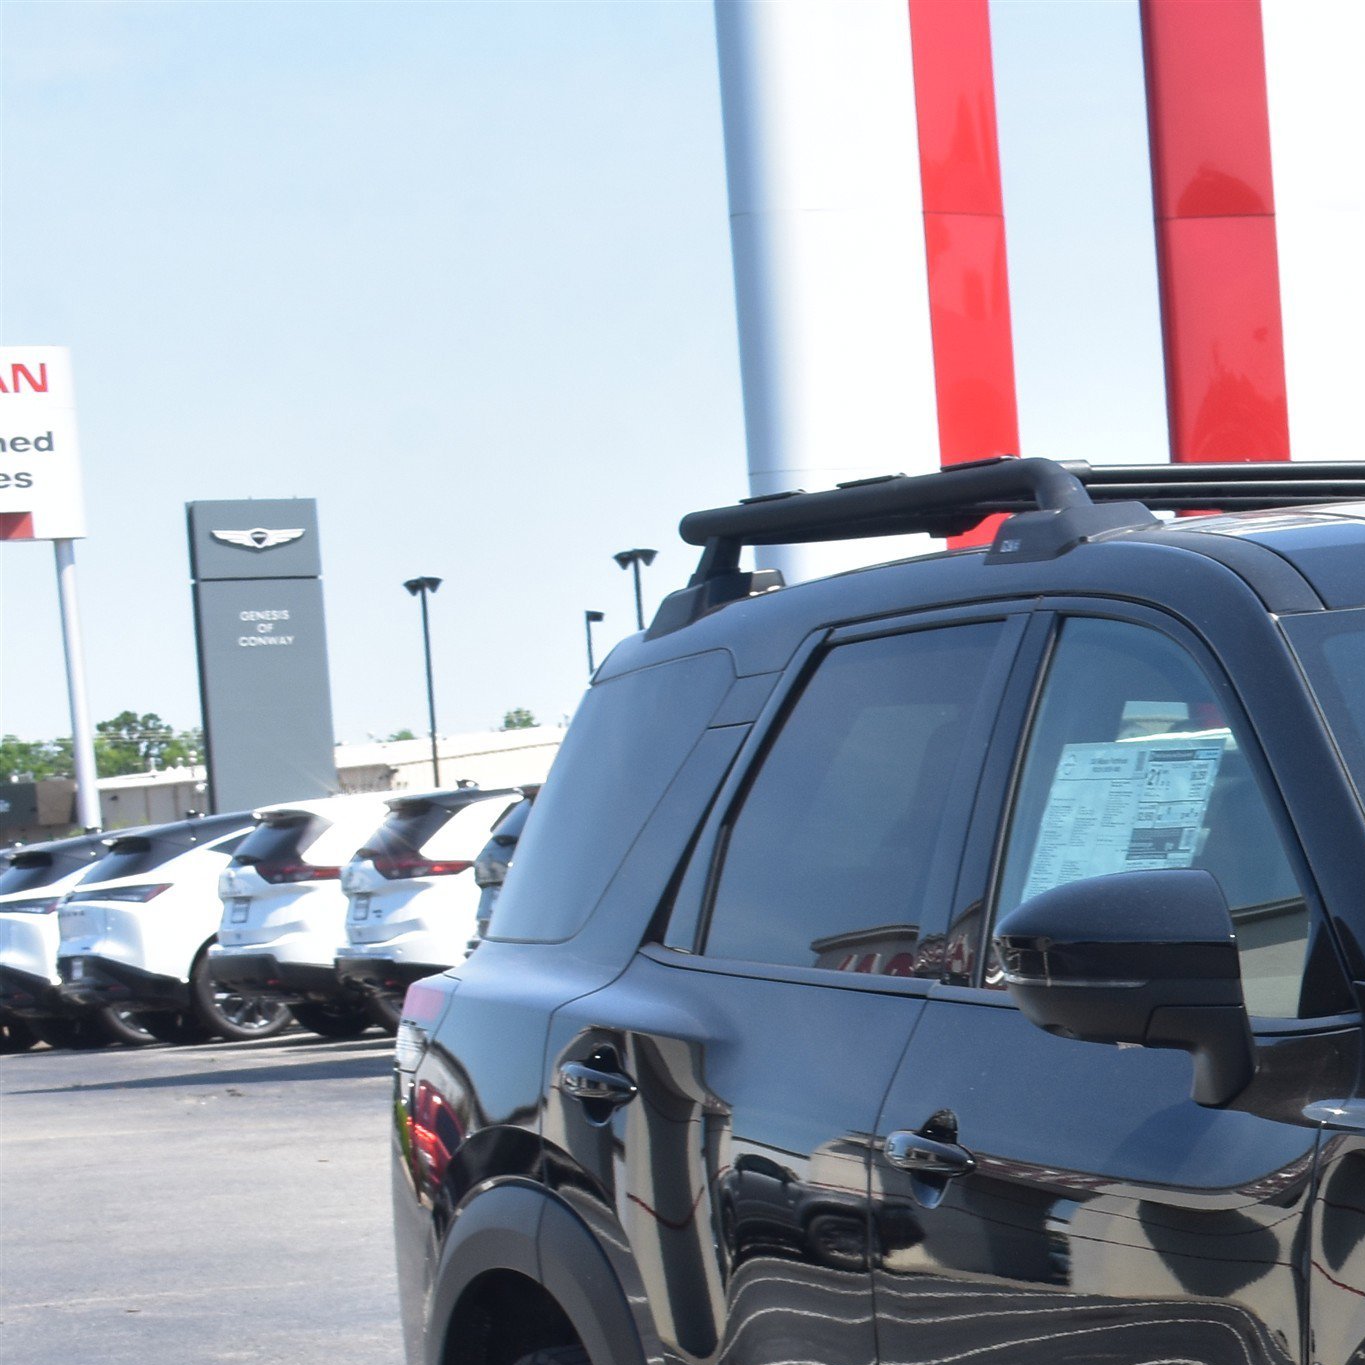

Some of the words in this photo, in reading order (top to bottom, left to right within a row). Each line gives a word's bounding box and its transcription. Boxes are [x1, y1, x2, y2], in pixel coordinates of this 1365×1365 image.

[0, 363, 49, 393] N
[239, 610, 290, 621] GENESIS
[257, 623, 274, 634] OF
[238, 635, 295, 647] CONWAY
